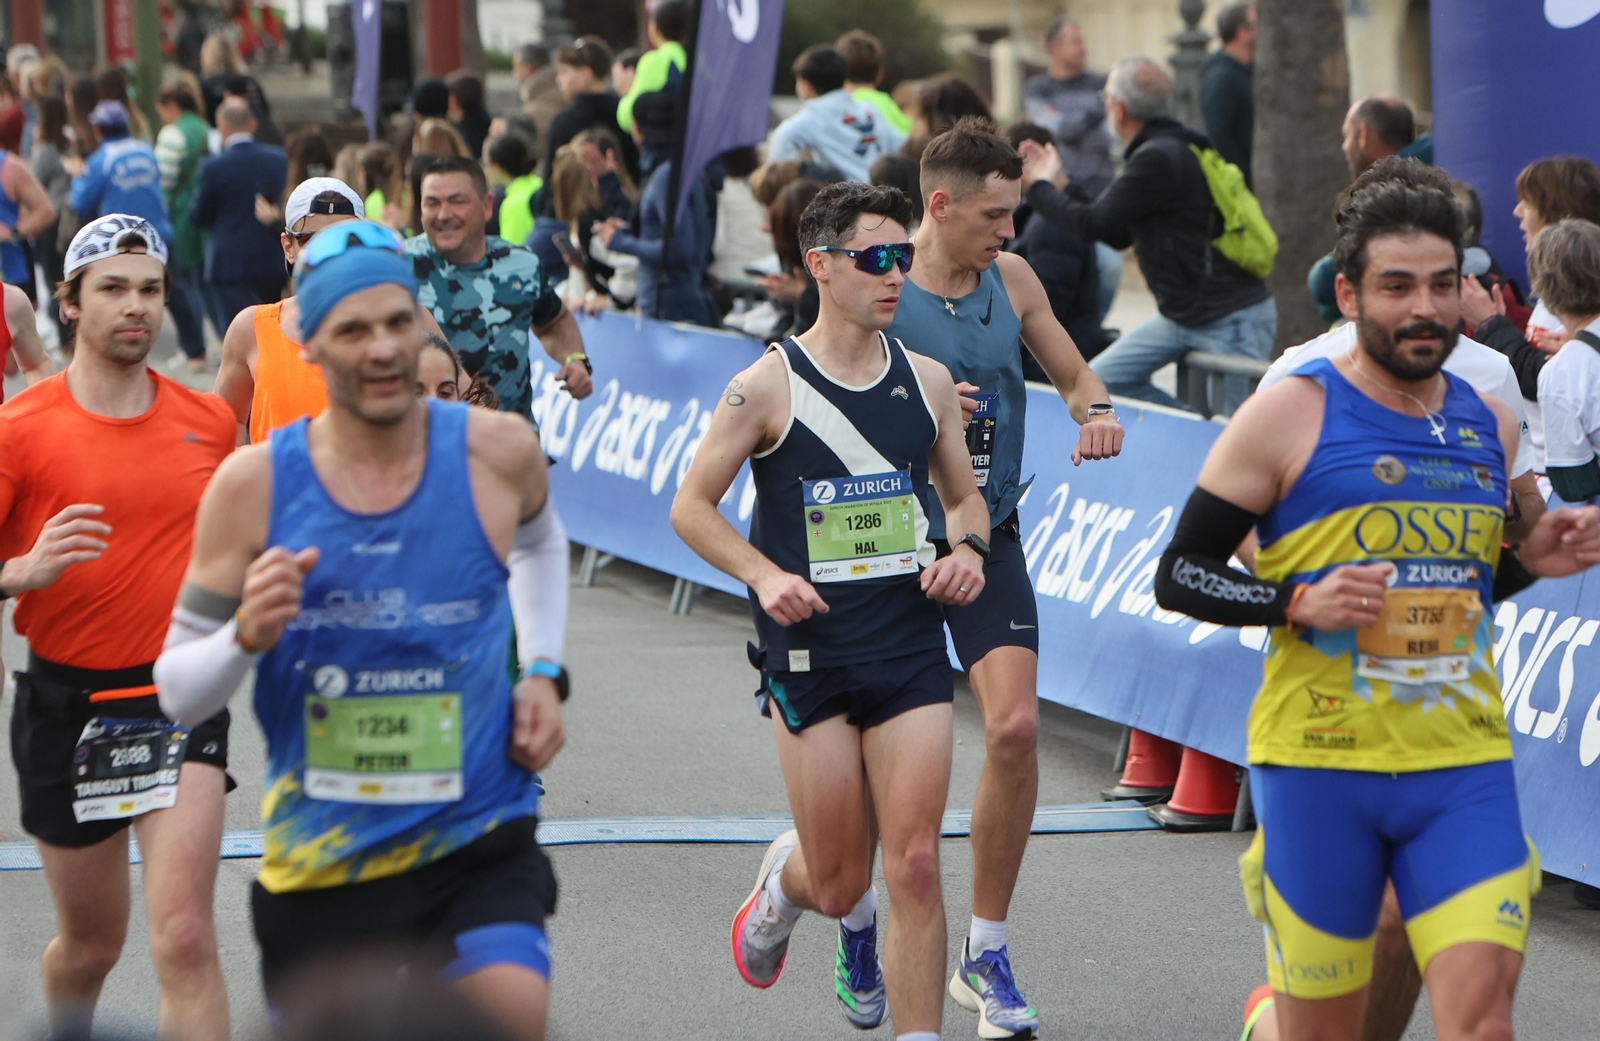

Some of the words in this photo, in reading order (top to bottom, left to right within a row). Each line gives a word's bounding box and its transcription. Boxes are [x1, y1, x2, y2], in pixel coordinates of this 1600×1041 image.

[596, 390, 671, 480] asics
[842, 477, 902, 497] ZURICH
[845, 512, 882, 531] 1286
[1355, 506, 1505, 557] OSSET
[854, 541, 879, 555] HAL
[1036, 497, 1136, 603] asics
[1406, 564, 1469, 583] ZURICH
[354, 667, 445, 693] ZURICH
